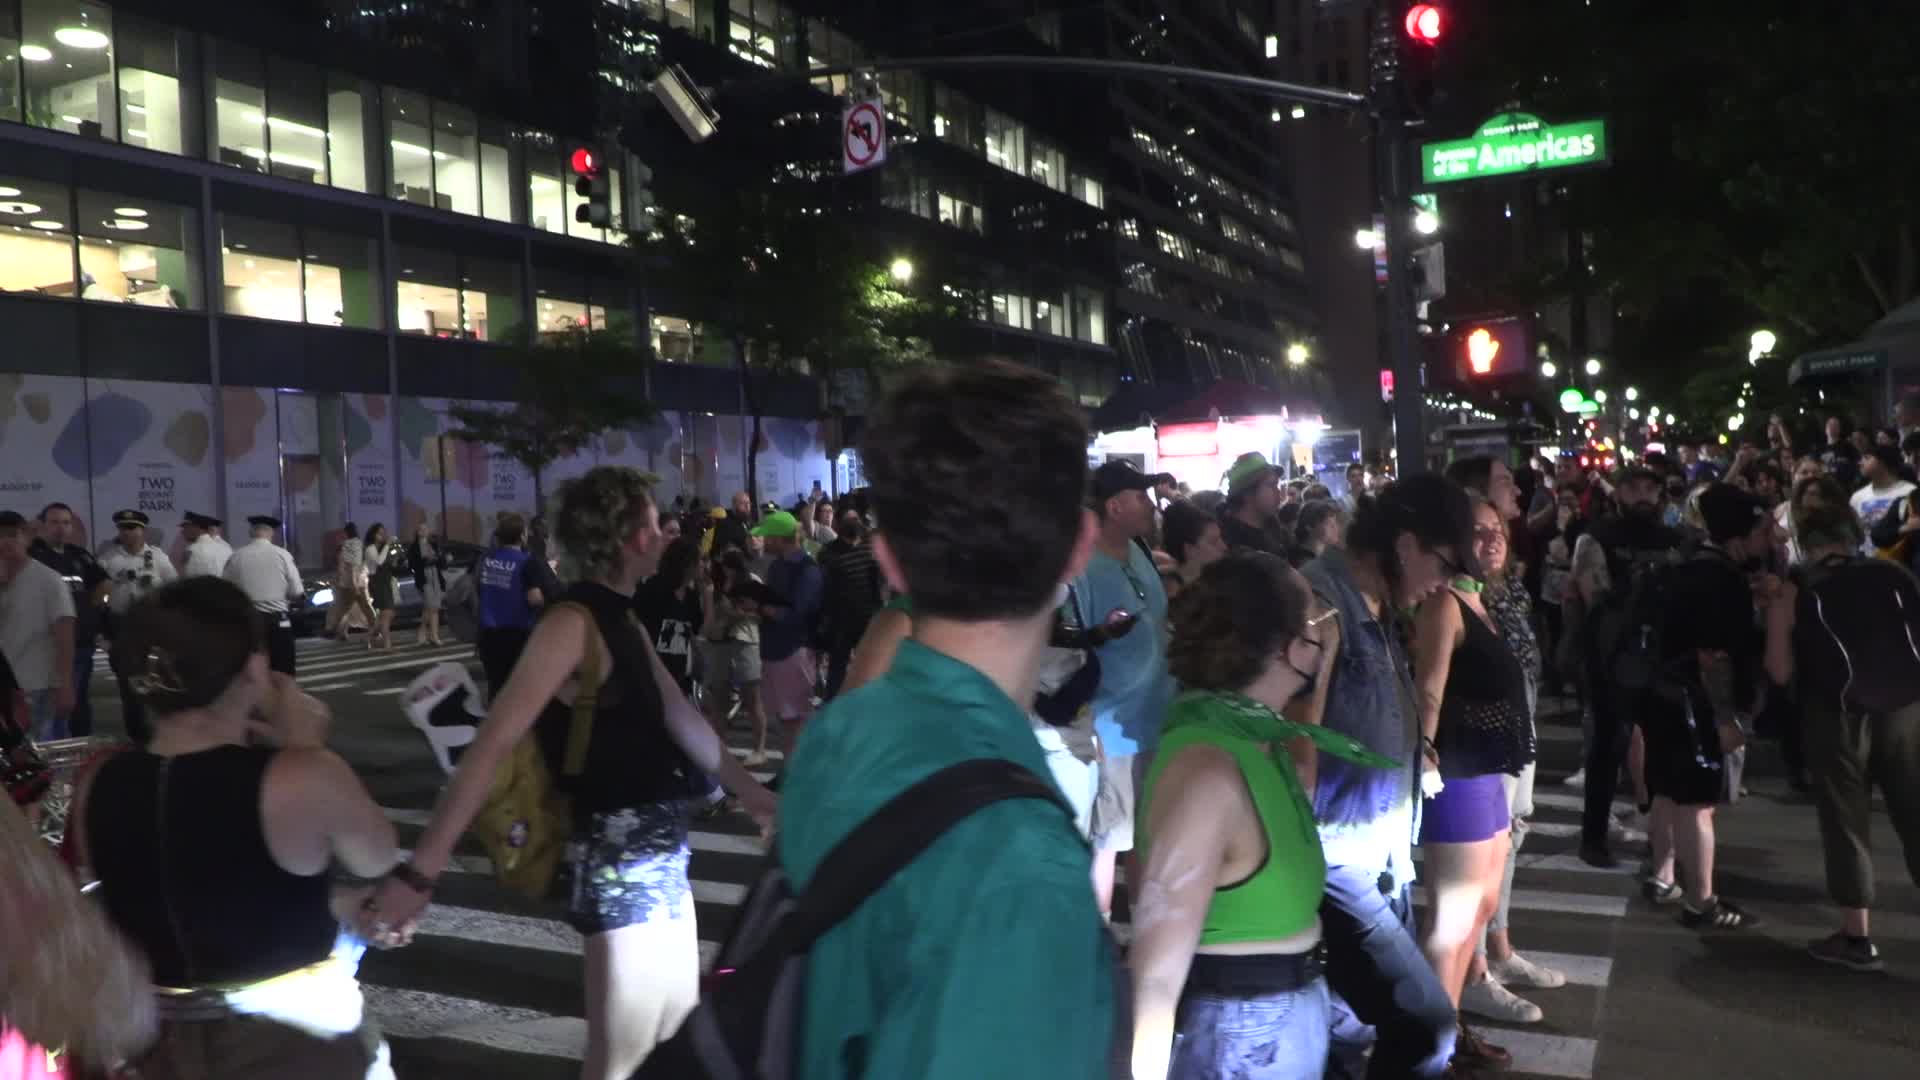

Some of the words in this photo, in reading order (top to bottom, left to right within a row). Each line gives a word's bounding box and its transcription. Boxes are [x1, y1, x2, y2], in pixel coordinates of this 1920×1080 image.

[1477, 133, 1596, 171] Americas
[139, 477, 175, 490] TWO
[360, 476, 386, 488] TWO
[139, 500, 175, 512] PARK
